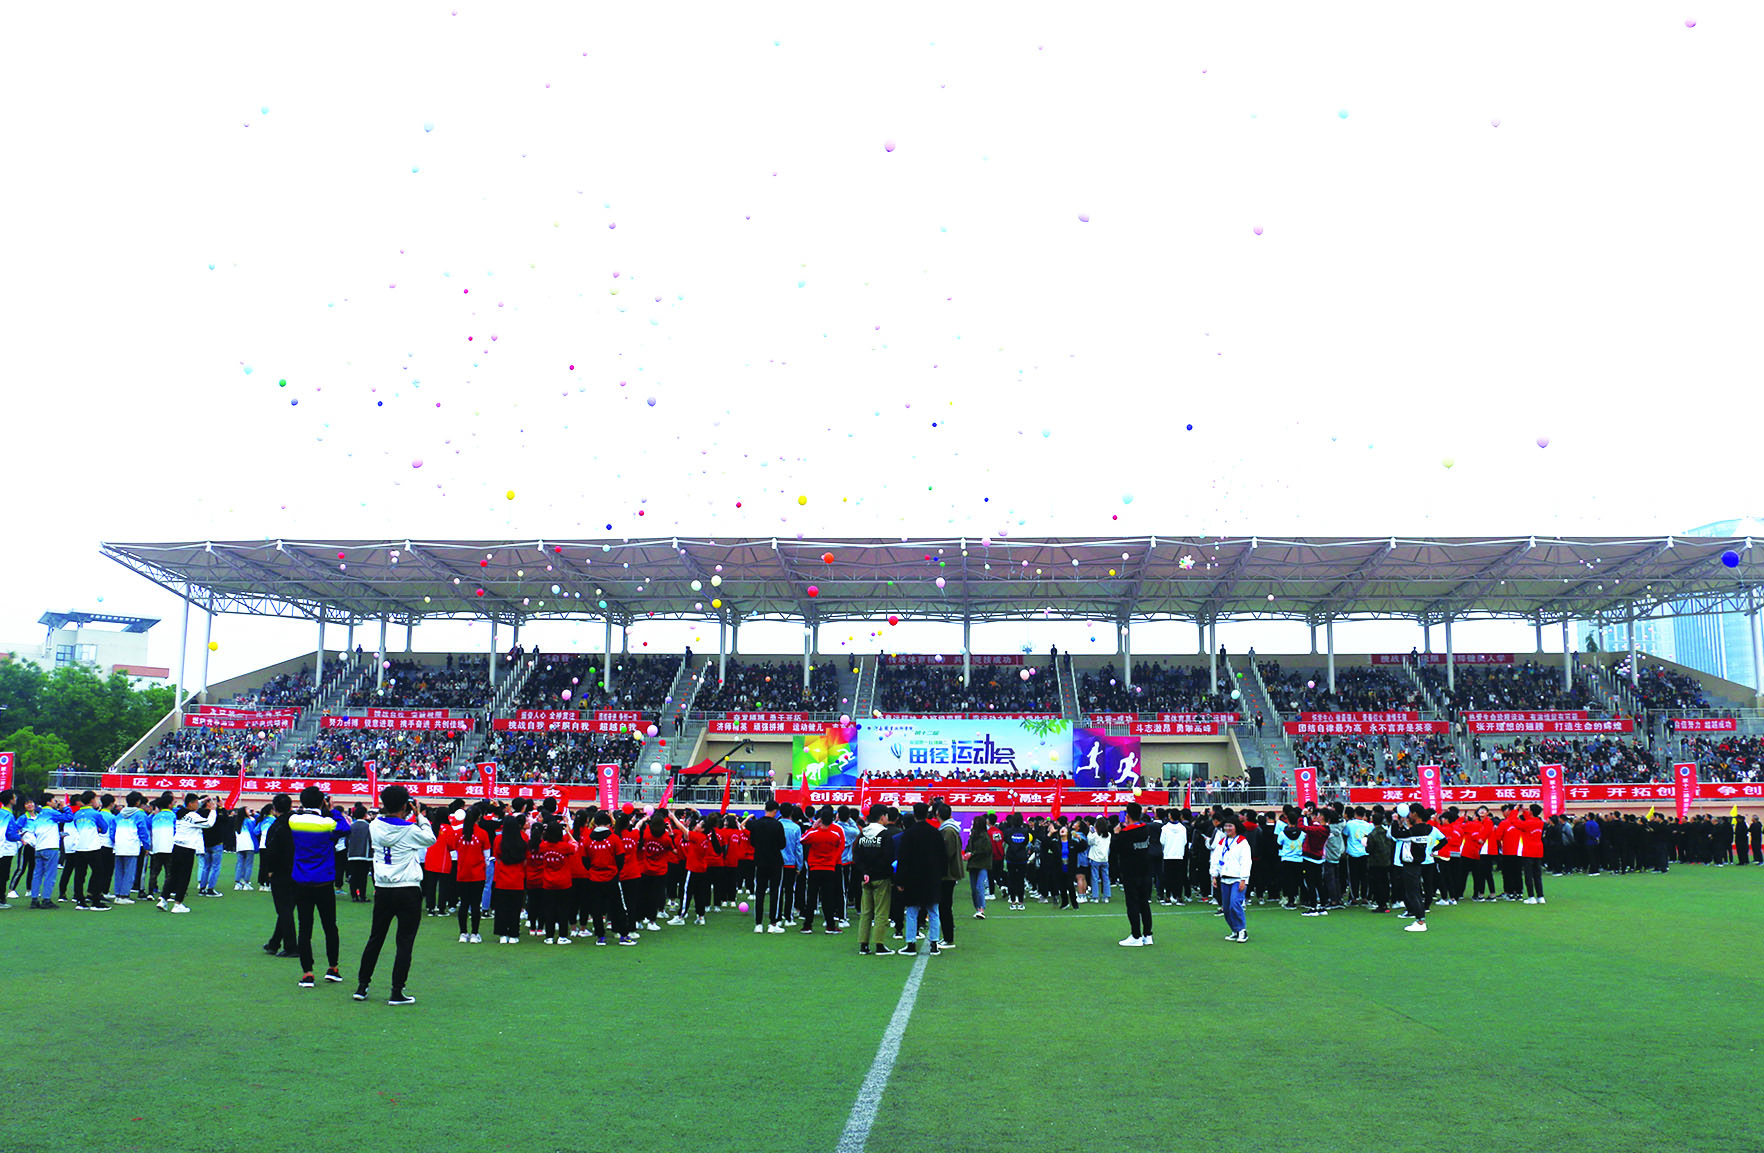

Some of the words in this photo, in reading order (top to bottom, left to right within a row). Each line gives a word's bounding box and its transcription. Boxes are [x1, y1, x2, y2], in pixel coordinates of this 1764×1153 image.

[329, 718, 358, 727] 努力拼搏
[364, 719, 394, 728] 锐意进取
[508, 721, 545, 730] 挑战自我
[132, 777, 220, 789] 匠心筑梦
[243, 780, 332, 792] 追求卓越
[465, 785, 562, 798] 超越自我
[1495, 787, 1590, 799] 砥砺行
[1607, 786, 1700, 797] 开拓创
[809, 791, 855, 803] 创新
[878, 791, 925, 803] 质量
[949, 792, 996, 803] 开放
[1019, 792, 1066, 803] 融合
[1090, 791, 1136, 803] 发展
